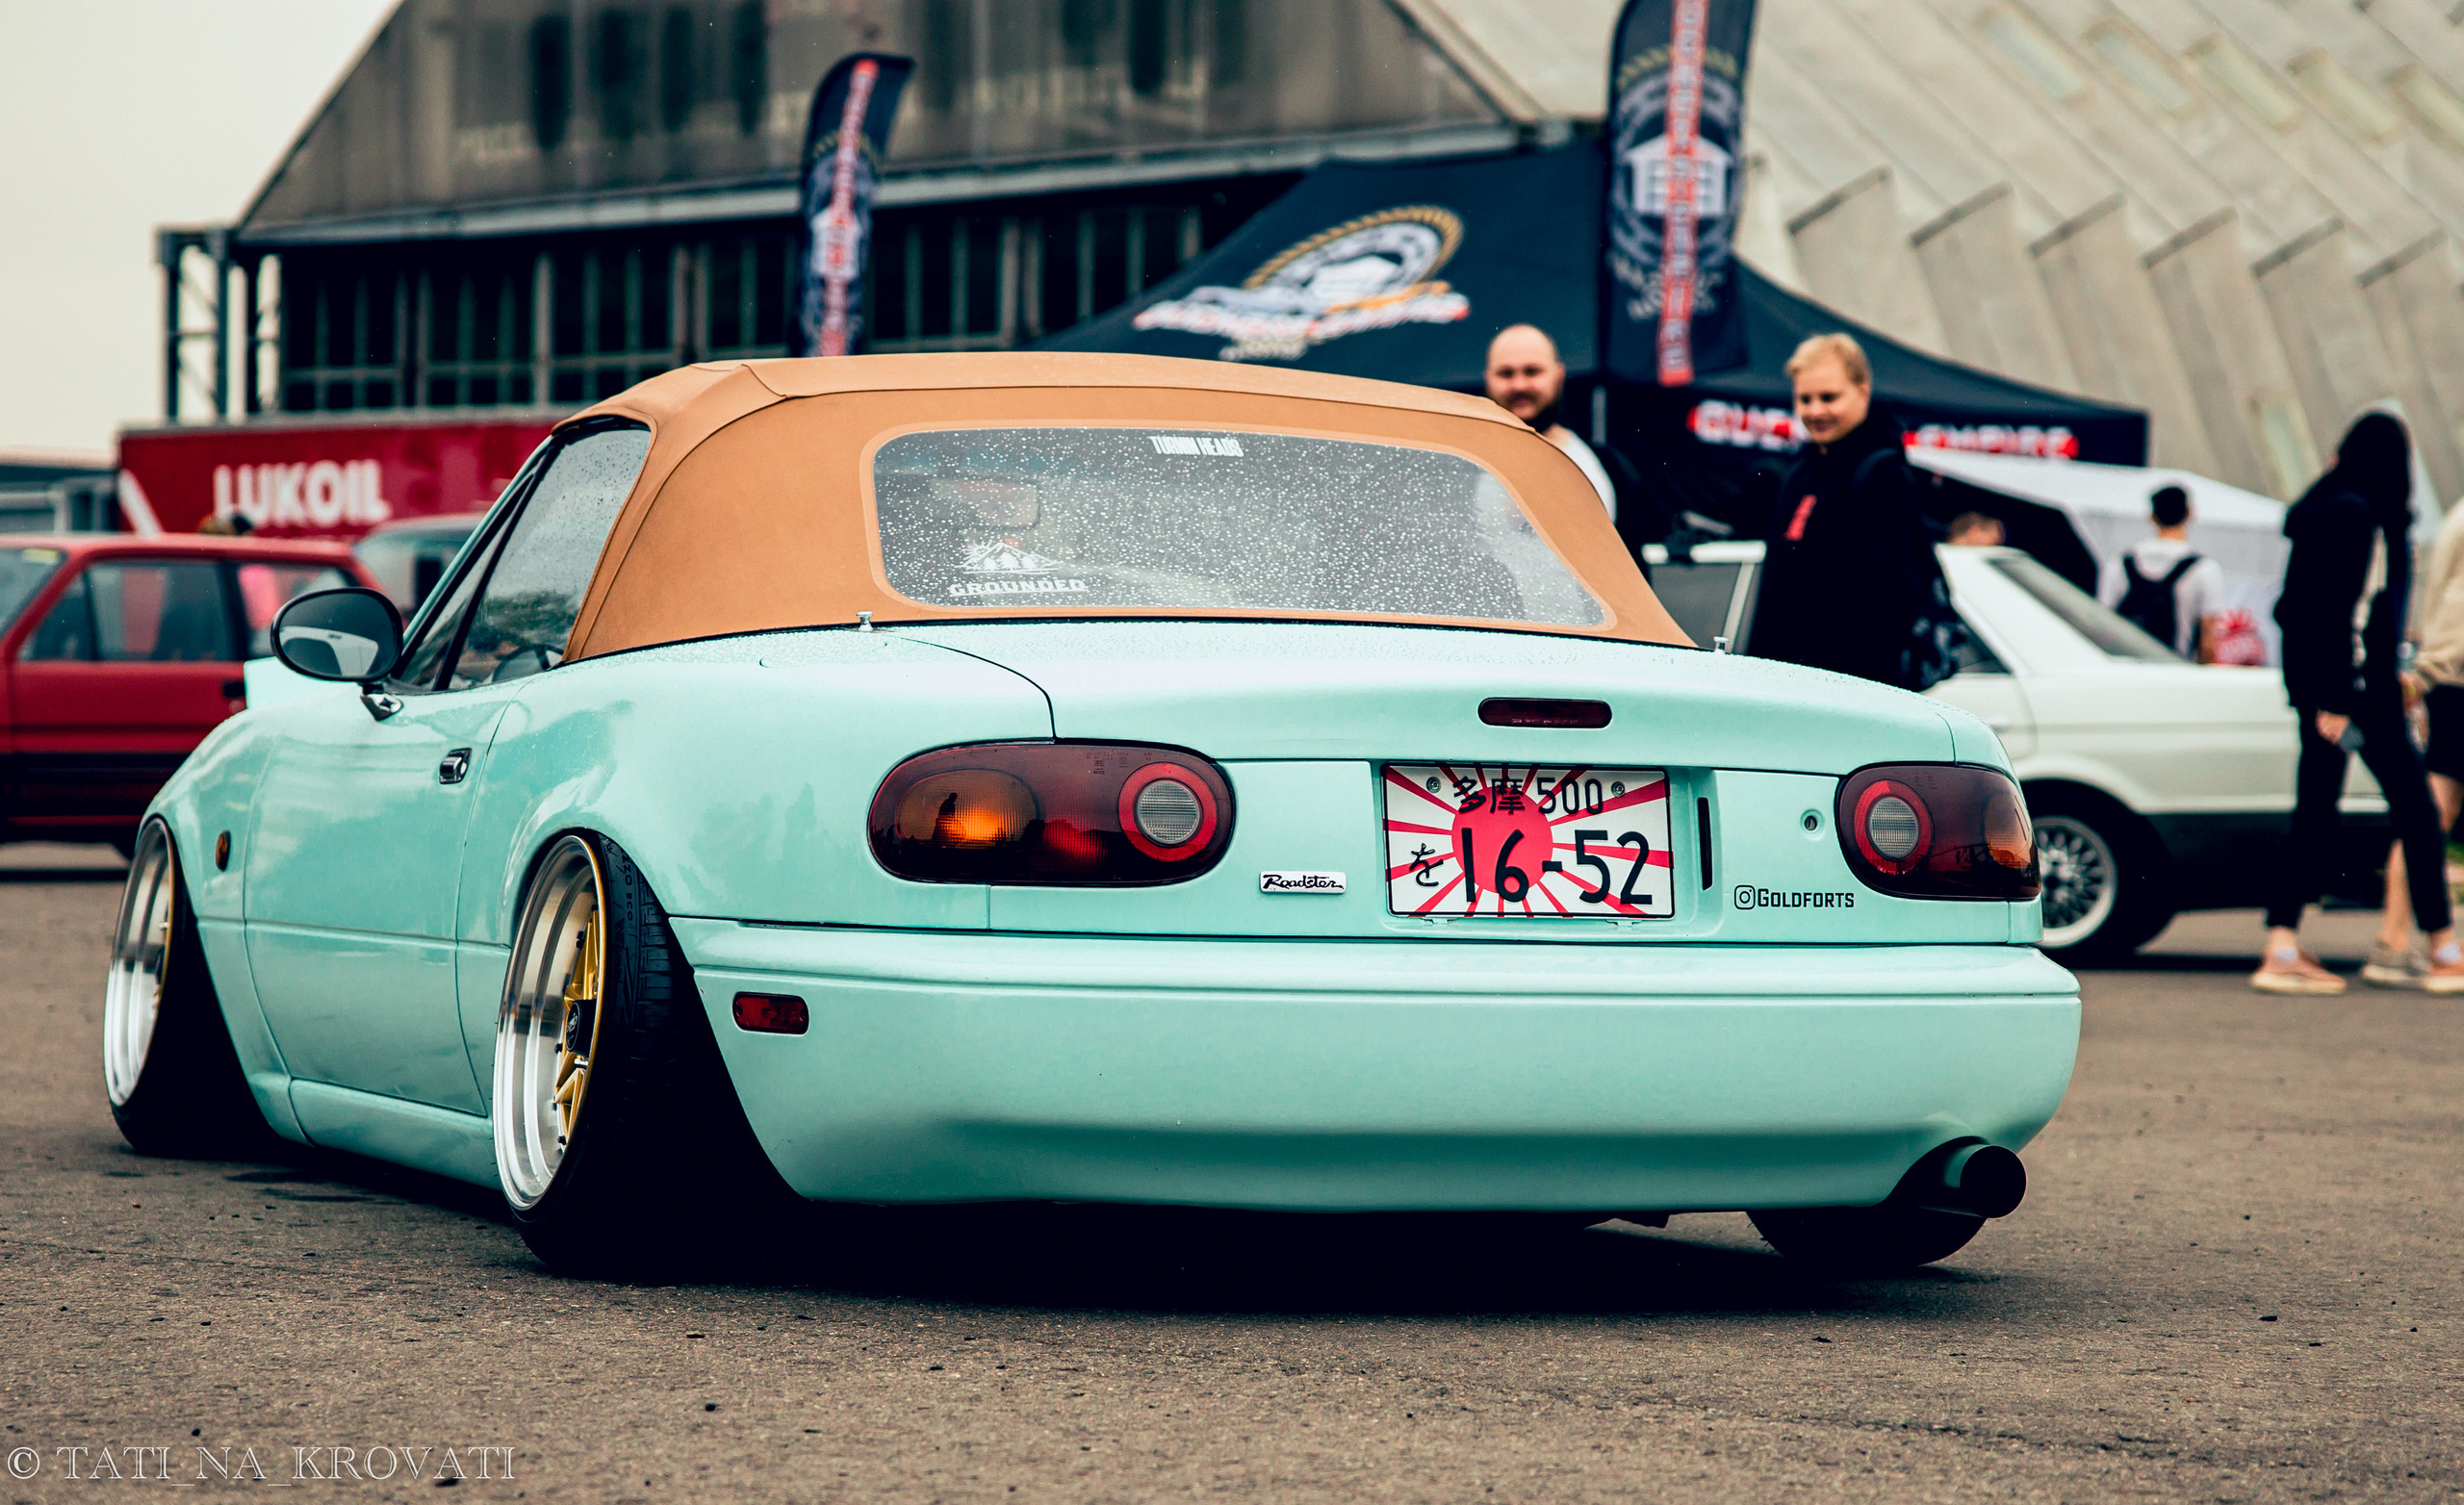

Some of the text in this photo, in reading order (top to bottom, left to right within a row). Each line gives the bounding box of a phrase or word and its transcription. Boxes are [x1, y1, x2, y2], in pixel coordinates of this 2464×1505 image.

[1195, 437, 1244, 457] HEADS
[214, 459, 393, 528] LUKOIL
[948, 578, 1090, 596] GROUNDED
[1453, 776, 1604, 816] 多摩 500
[1409, 828, 1653, 905] を 16-52
[1263, 874, 1345, 890] Roadster
